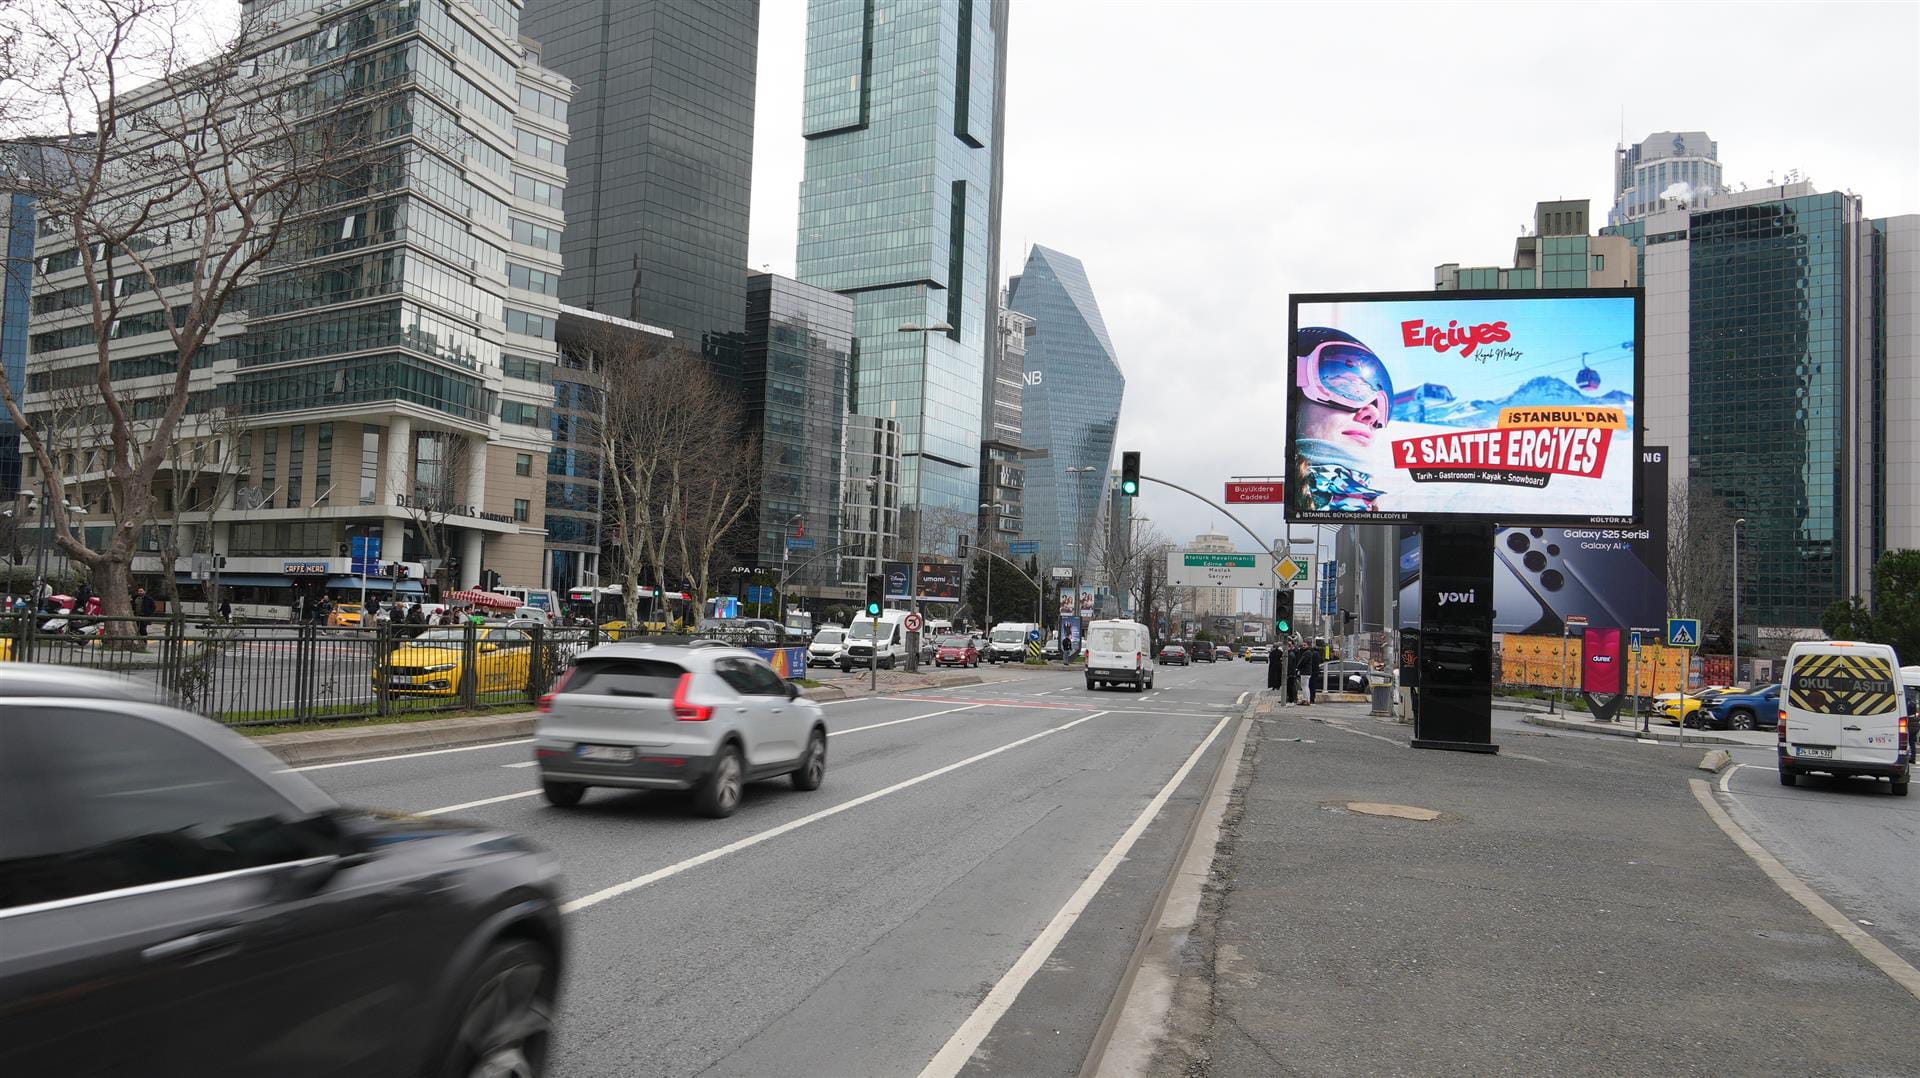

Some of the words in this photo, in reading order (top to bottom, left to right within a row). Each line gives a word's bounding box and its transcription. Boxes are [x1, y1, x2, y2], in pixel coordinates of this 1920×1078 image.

[1401, 319, 1511, 358] Erciyes
[1402, 441, 1417, 464] 2
[1421, 432, 1502, 465] SAATTE
[1416, 472, 1433, 480] Tarih
[1439, 472, 1476, 480] Gastronomi
[1482, 472, 1502, 482] Kayak
[1508, 474, 1545, 486] Snowboard
[480, 511, 513, 524] MARRIOTT
[1333, 511, 1371, 519] BÜYÜKŞEHİR
[1563, 530, 1601, 540] Galaxy
[1602, 531, 1619, 539] S25
[1621, 530, 1650, 539] Serisi
[1580, 542, 1611, 551] Galaxy
[306, 565, 324, 573] NERO
[731, 566, 751, 574] APA
[1438, 588, 1475, 606] yovi
[1799, 678, 1833, 689] OKUL
[1849, 681, 1888, 693] AŞITI
